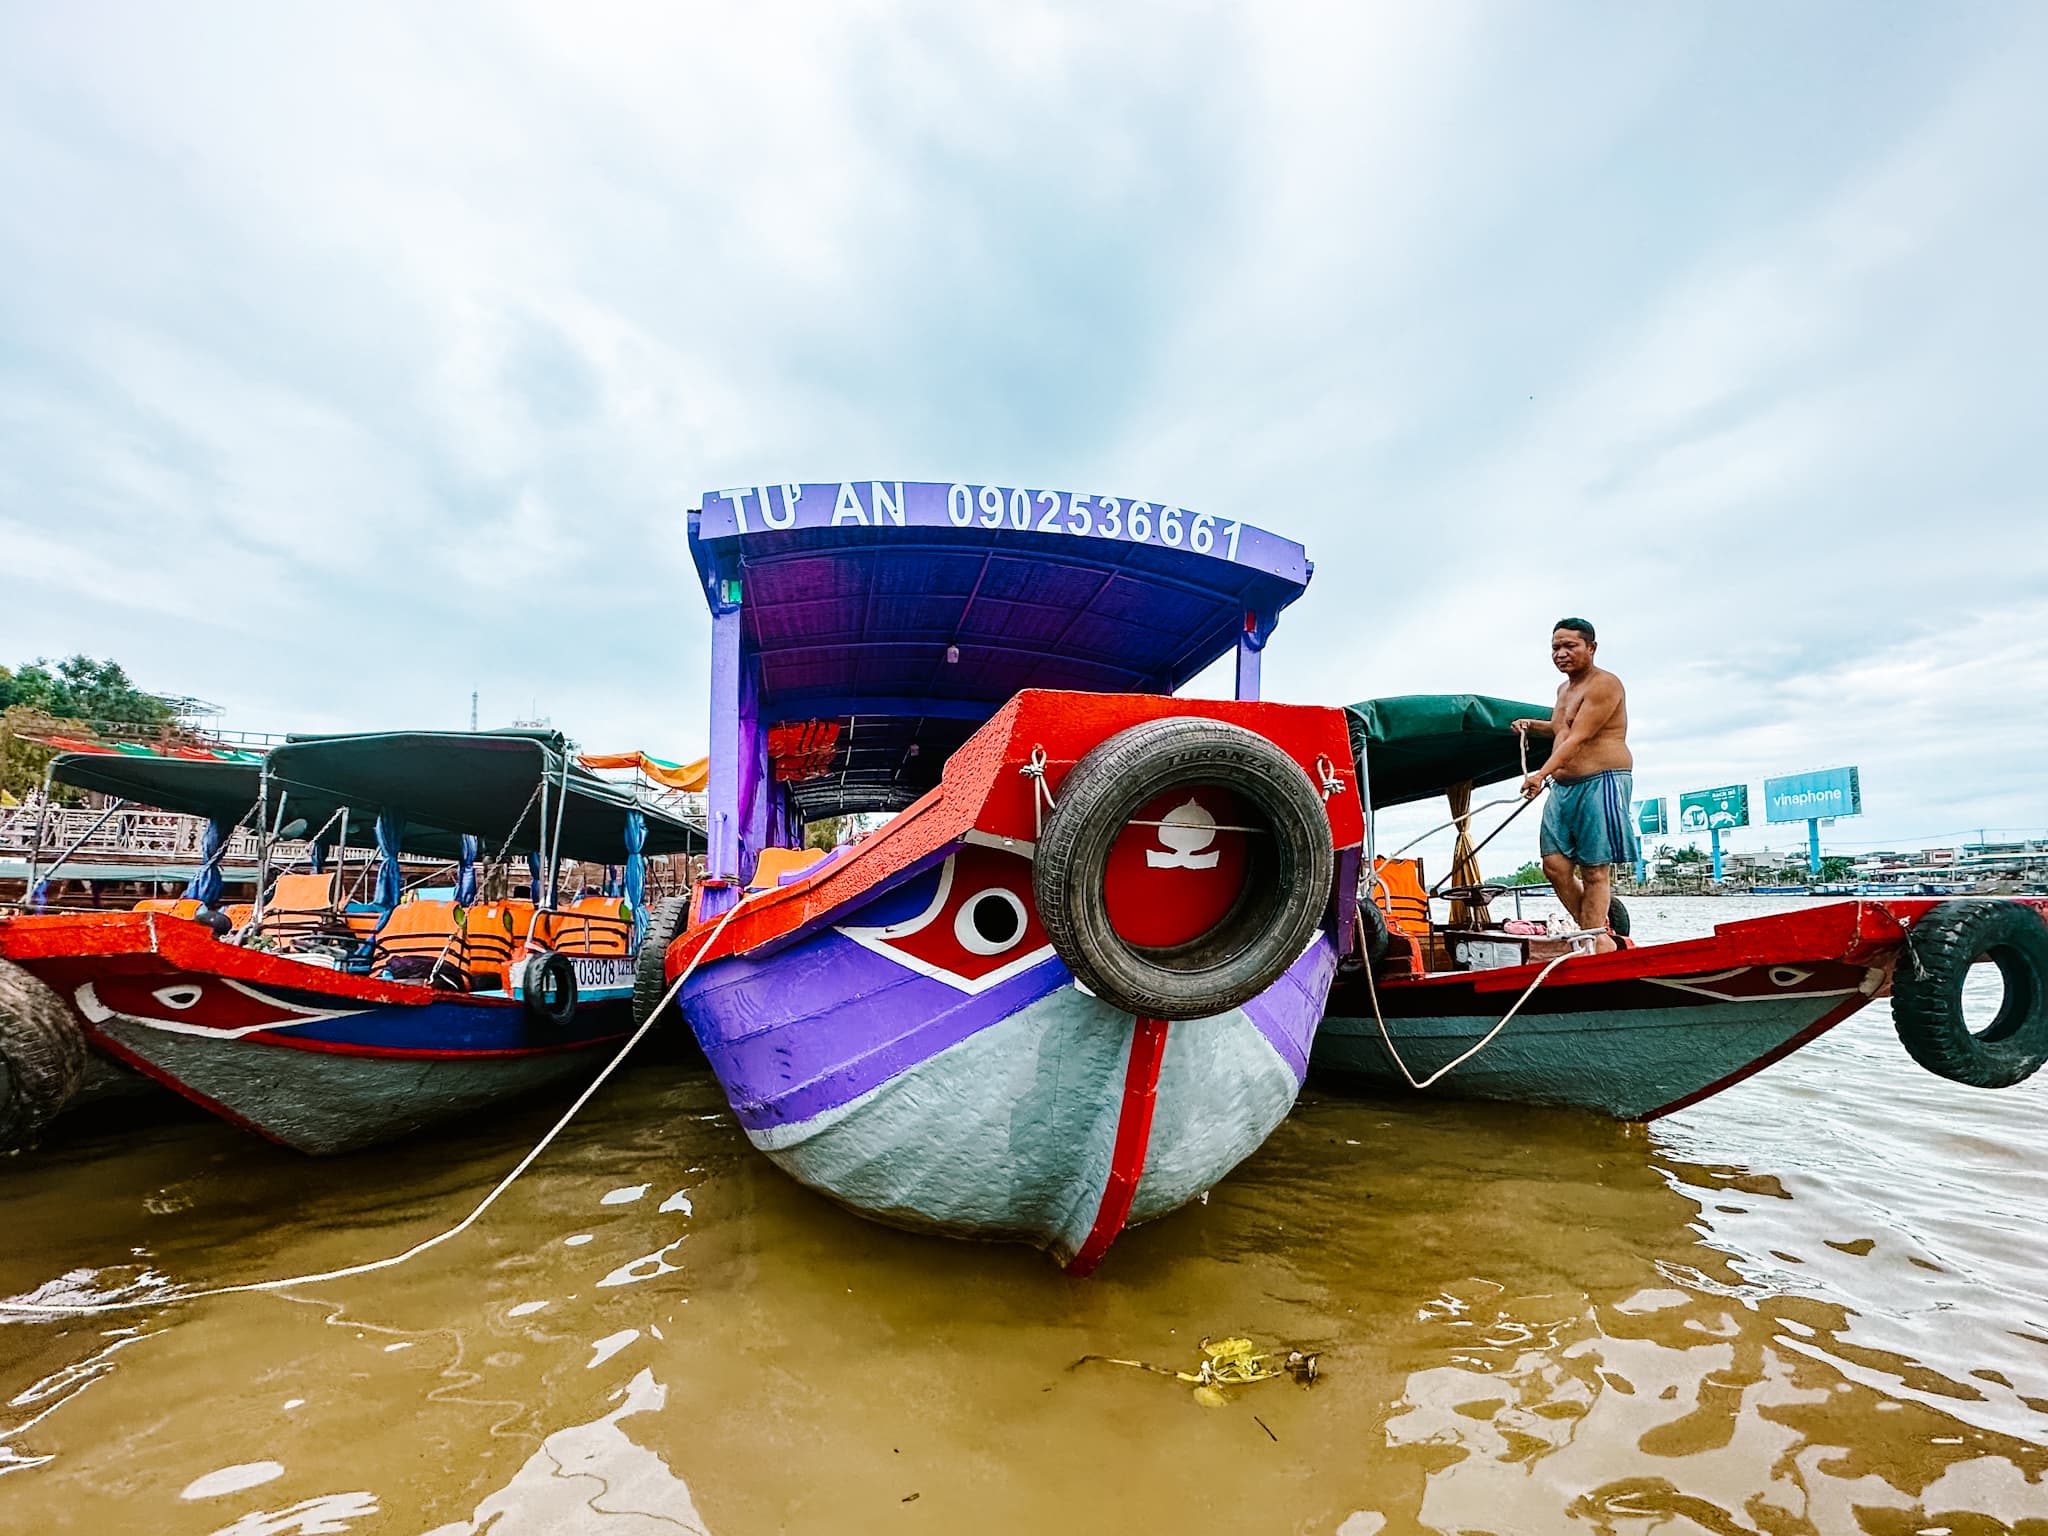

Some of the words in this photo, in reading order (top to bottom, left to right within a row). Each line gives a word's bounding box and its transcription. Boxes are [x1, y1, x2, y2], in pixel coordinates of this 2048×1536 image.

[719, 484, 801, 535] TƯ
[830, 481, 906, 527] AN
[946, 483, 1244, 561] 0902536661
[1166, 750, 1272, 774] TURANZA
[1773, 788, 1842, 807] vinaphone
